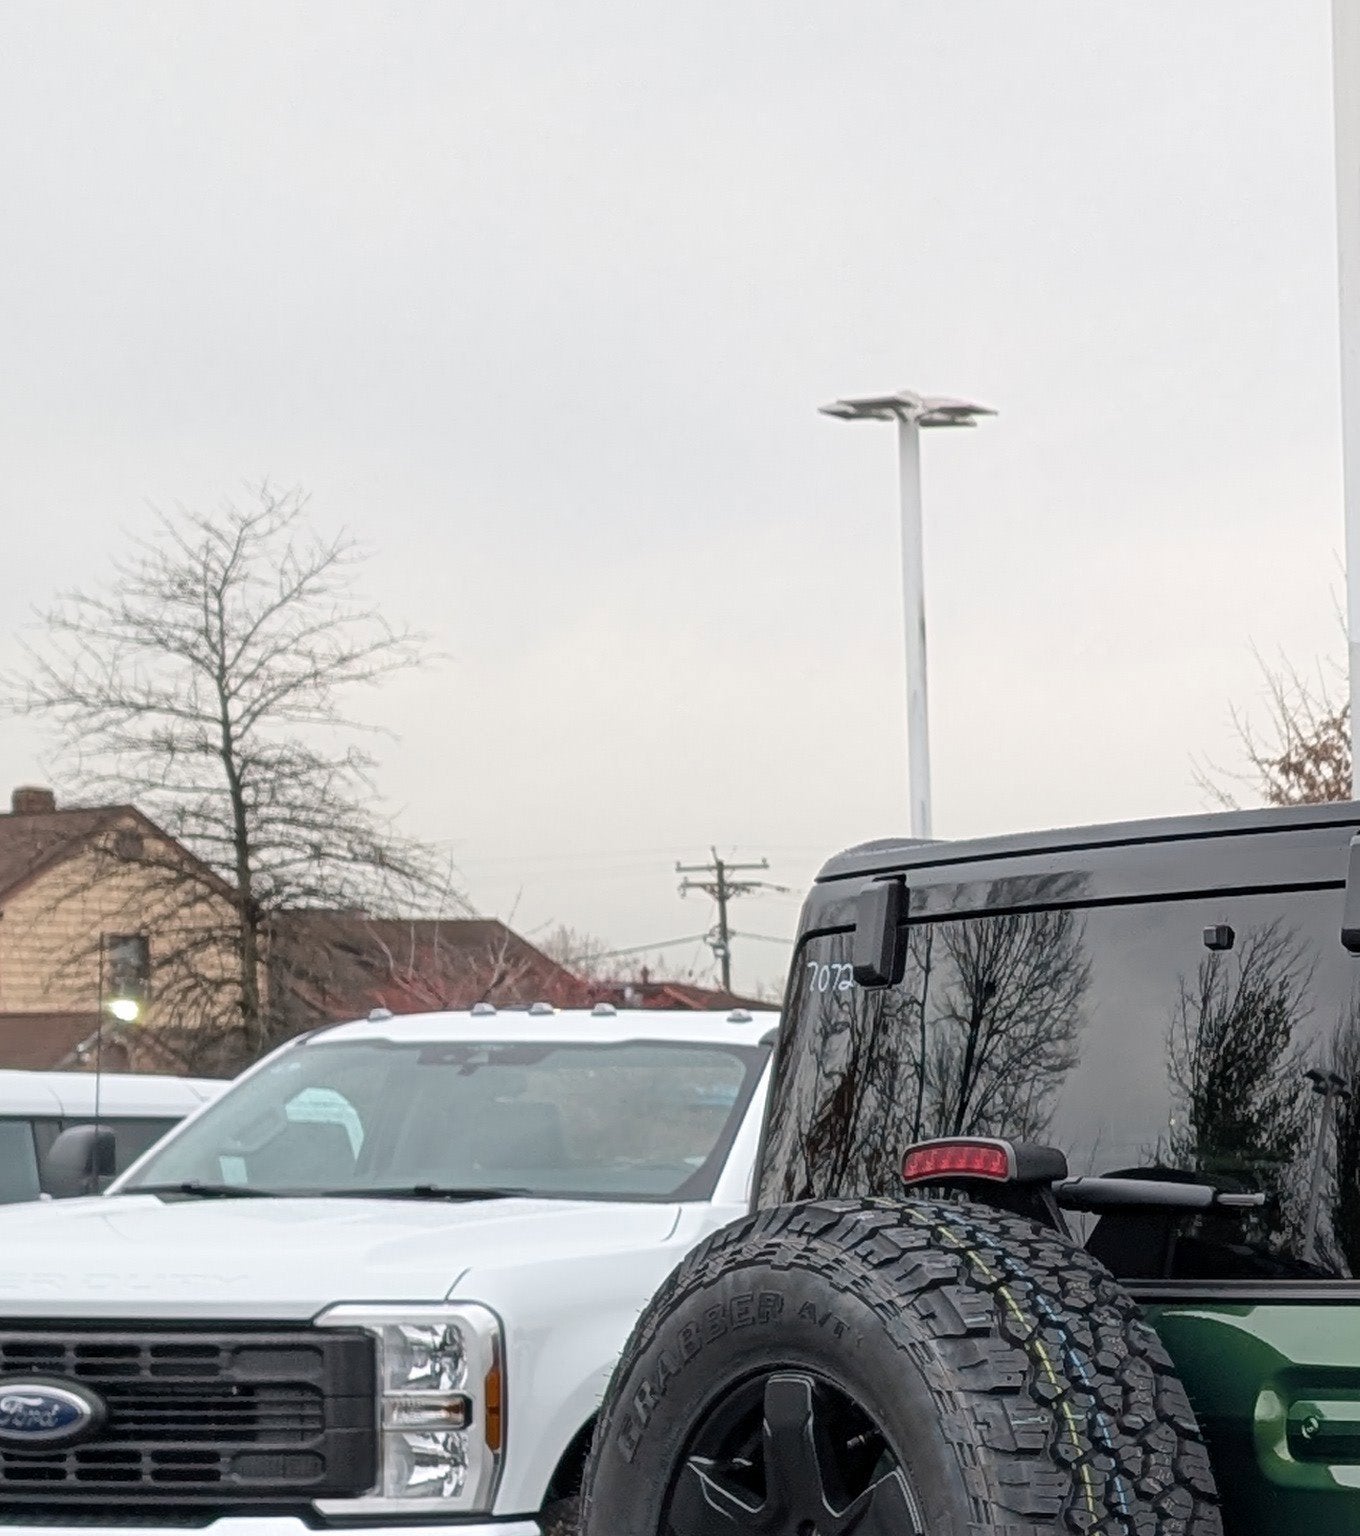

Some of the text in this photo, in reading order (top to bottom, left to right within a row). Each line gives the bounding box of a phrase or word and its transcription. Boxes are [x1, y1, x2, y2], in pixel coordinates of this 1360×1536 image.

[807, 961, 854, 991] 7072
[617, 1291, 785, 1463] GRABBER
[0, 1395, 61, 1428] Ford
